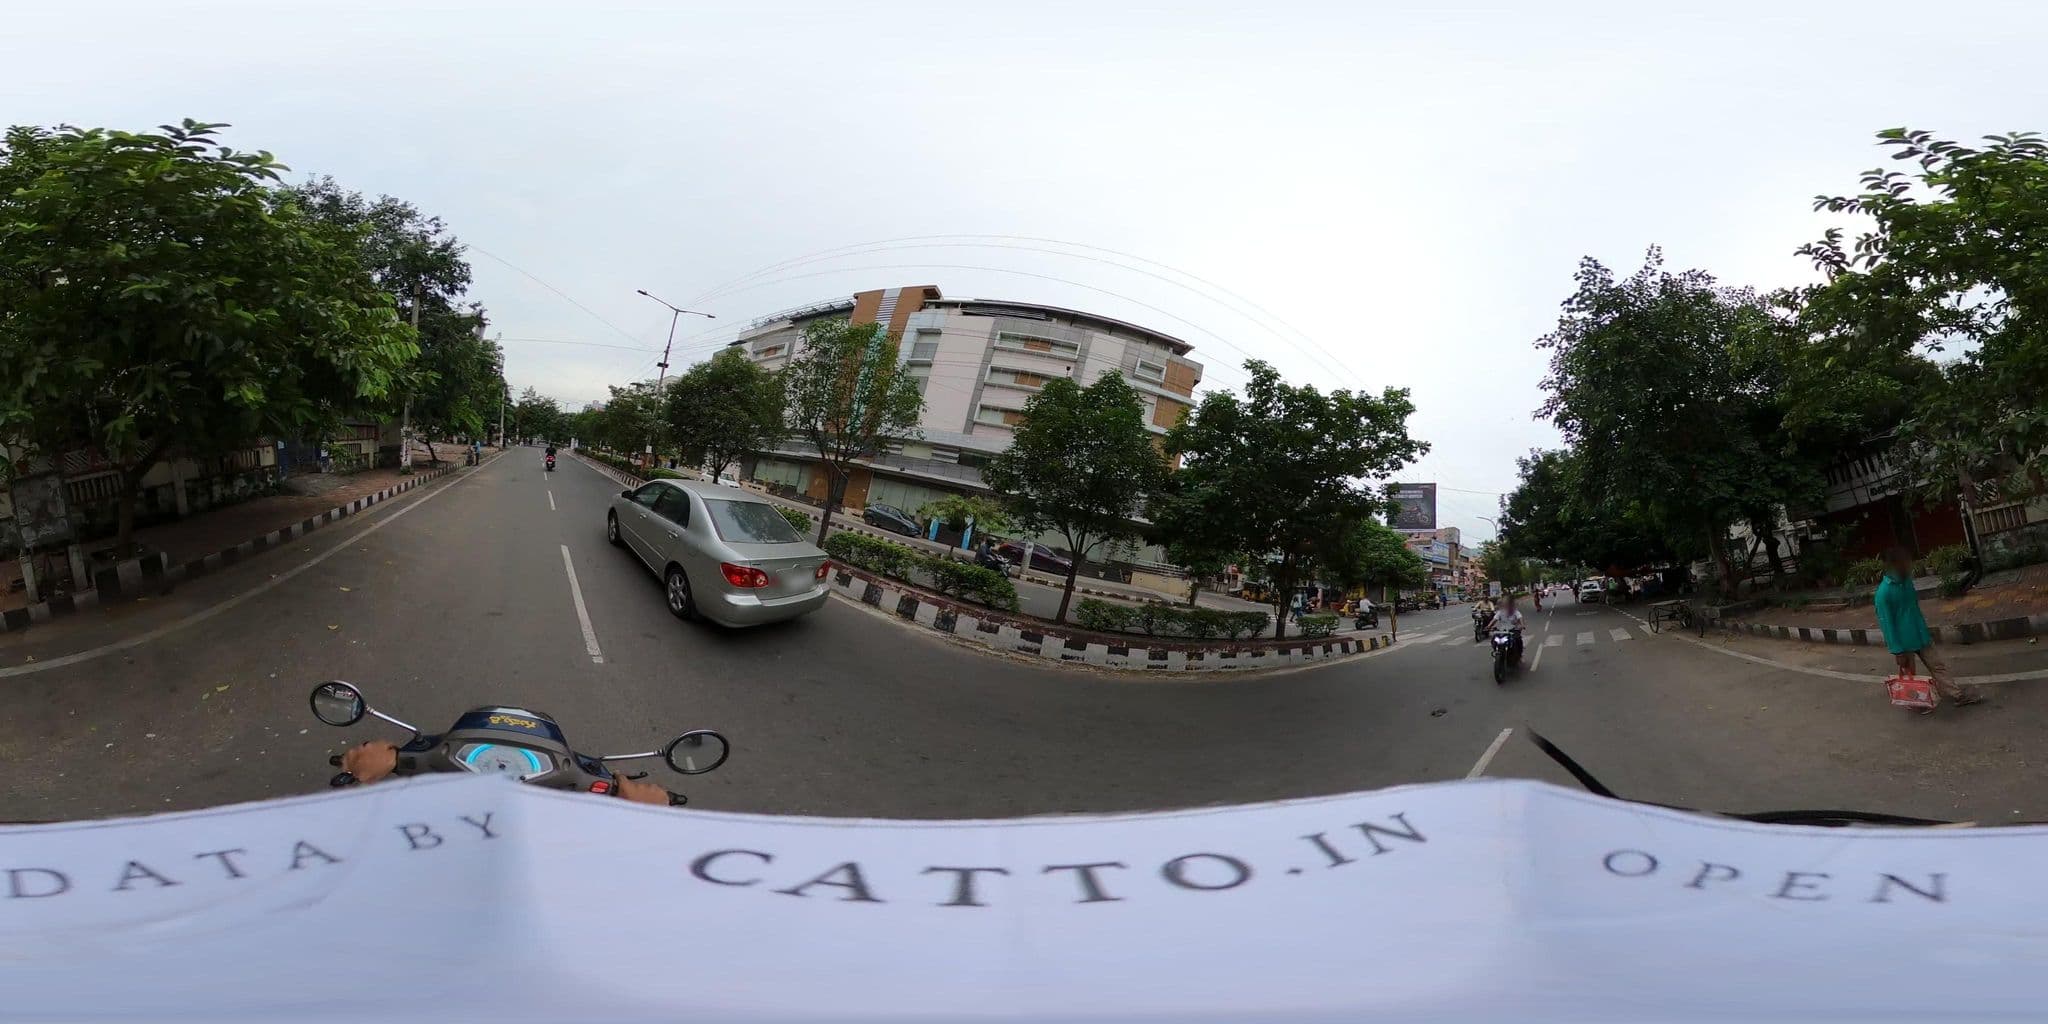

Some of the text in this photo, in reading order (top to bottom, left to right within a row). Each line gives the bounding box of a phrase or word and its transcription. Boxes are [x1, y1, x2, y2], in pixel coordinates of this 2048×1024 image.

[5, 812, 501, 899] DATA BY
[690, 811, 1428, 908] CATTO.IN
[1602, 849, 1948, 904] OPEN
